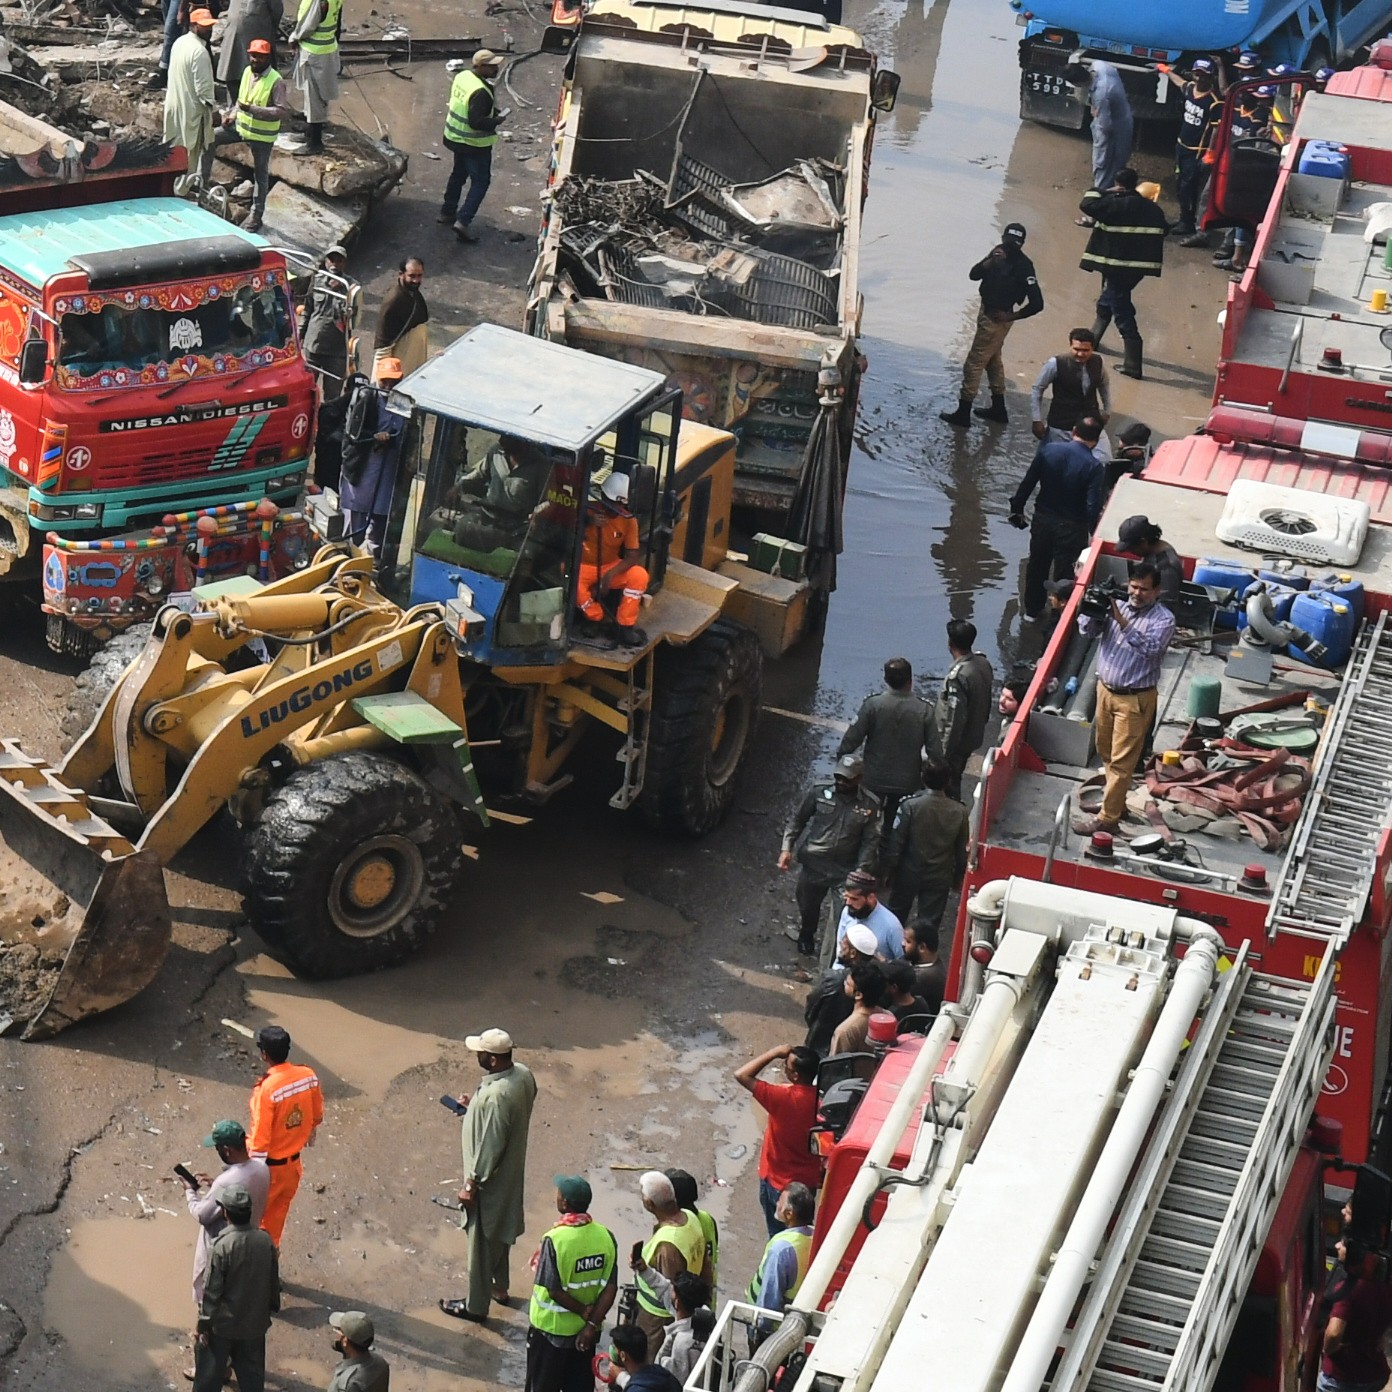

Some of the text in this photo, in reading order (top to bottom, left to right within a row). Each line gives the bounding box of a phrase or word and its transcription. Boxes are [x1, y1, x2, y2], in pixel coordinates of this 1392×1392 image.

[1032, 82, 1060, 94] 599
[110, 401, 279, 431] NISSAN DIESEL
[576, 1255, 604, 1271] KMC
